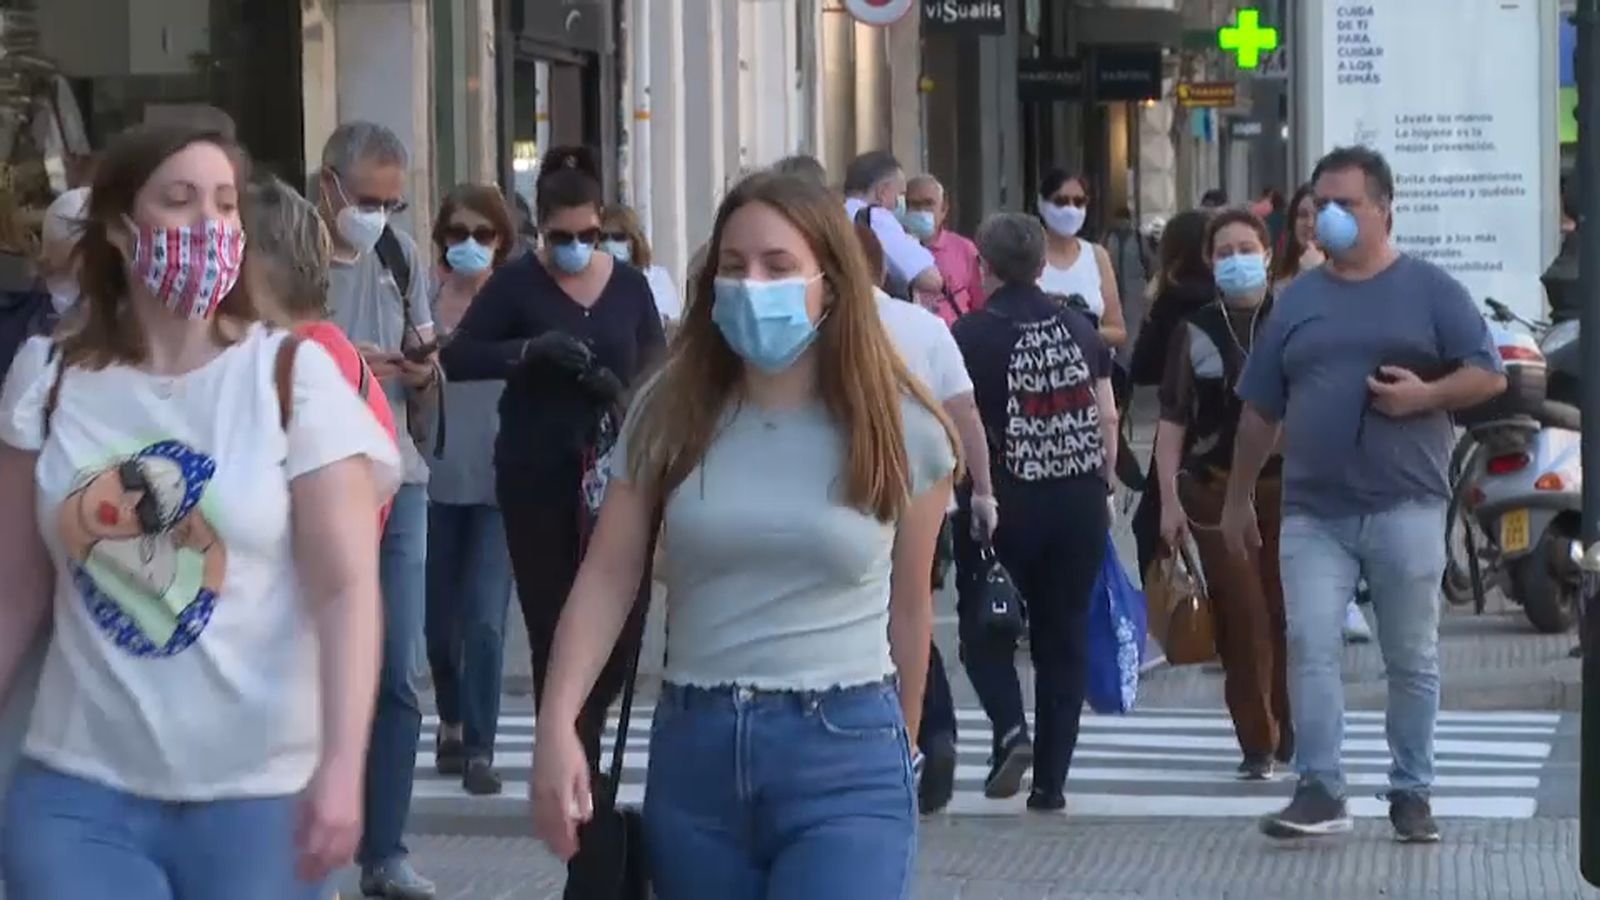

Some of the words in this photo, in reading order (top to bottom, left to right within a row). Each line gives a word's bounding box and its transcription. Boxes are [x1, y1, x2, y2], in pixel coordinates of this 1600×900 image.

[1337, 6, 1375, 17] CUIDA
[1337, 20, 1352, 31] DE
[1337, 34, 1371, 44] PARA
[1337, 47, 1384, 58] CUIDAR
[1337, 61, 1347, 71] A
[1349, 60, 1374, 71] LOS
[1337, 72, 1382, 85] DEMÁS
[1395, 114, 1433, 124] Lávate
[1395, 128, 1409, 139] La
[1411, 128, 1453, 140] higiene
[1456, 129, 1469, 138] es
[1471, 127, 1483, 138] la
[1395, 142, 1429, 154] mejor
[1427, 172, 1523, 185] desplazamientos
[1479, 186, 1526, 199] quédate
[1395, 204, 1410, 213] en
[1474, 231, 1497, 243] más
